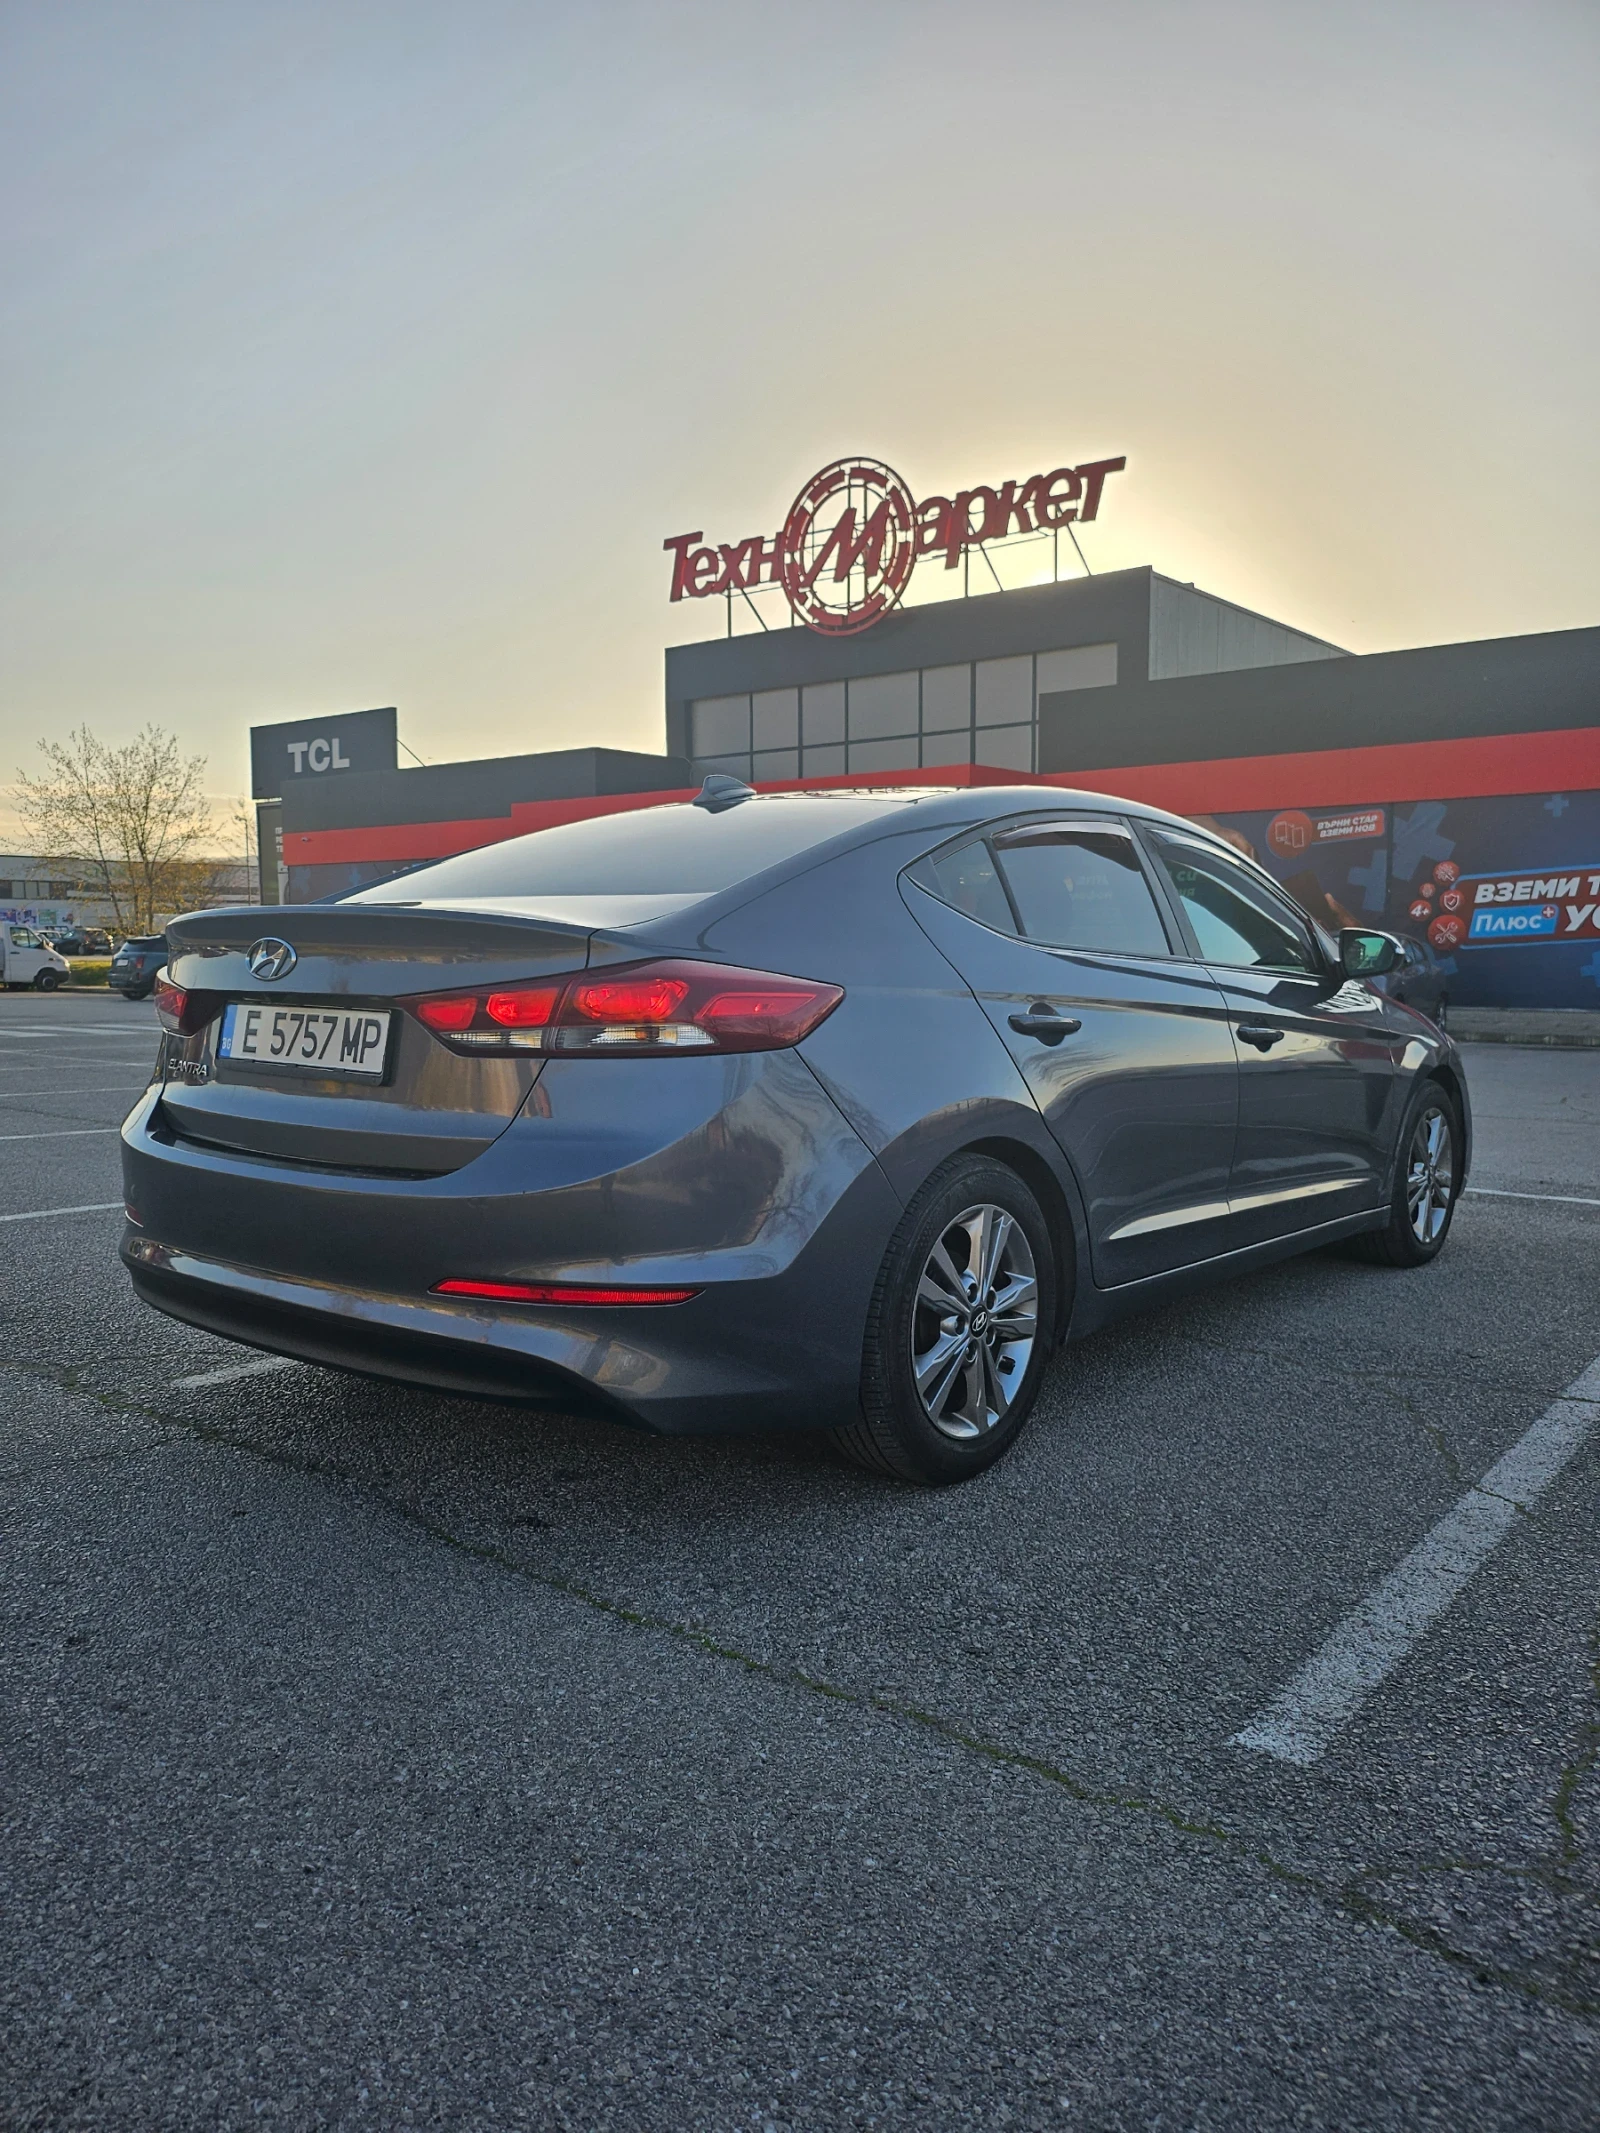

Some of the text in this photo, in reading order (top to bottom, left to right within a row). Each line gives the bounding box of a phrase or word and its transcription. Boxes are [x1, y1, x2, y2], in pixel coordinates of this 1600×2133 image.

[287, 738, 350, 773] TCL
[1317, 814, 1378, 831] ВЪРНИ СТАР
[1320, 823, 1376, 838] ВЗЕМИ НОВ
[1474, 876, 1580, 904] ВЗЕМИ
[1411, 904, 1430, 917] 4+
[242, 1010, 382, 1064] E 5757 MP
